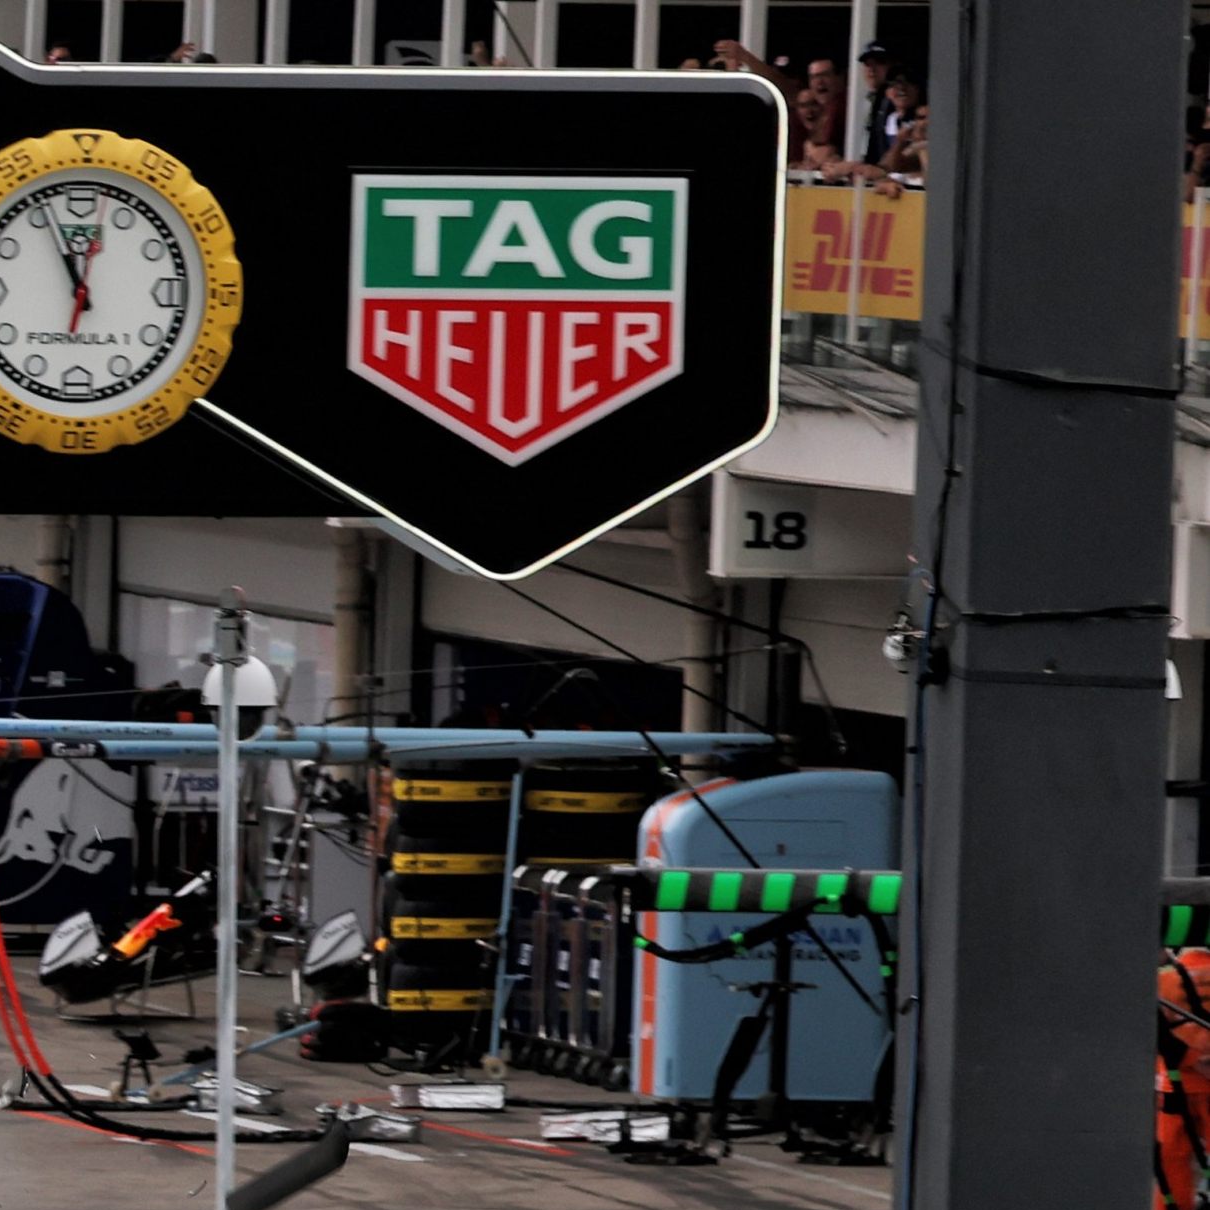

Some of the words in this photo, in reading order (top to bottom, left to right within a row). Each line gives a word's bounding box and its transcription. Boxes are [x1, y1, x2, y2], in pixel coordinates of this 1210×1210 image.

[141, 150, 178, 180] 05
[198, 204, 224, 234] 10
[382, 199, 653, 280] TAG
[26, 332, 116, 346] FORMULA
[122, 333, 130, 346] 1
[372, 309, 661, 438] HEUER
[62, 431, 99, 450] 30
[743, 511, 807, 550] 18
[51, 742, 97, 758] Gulf
